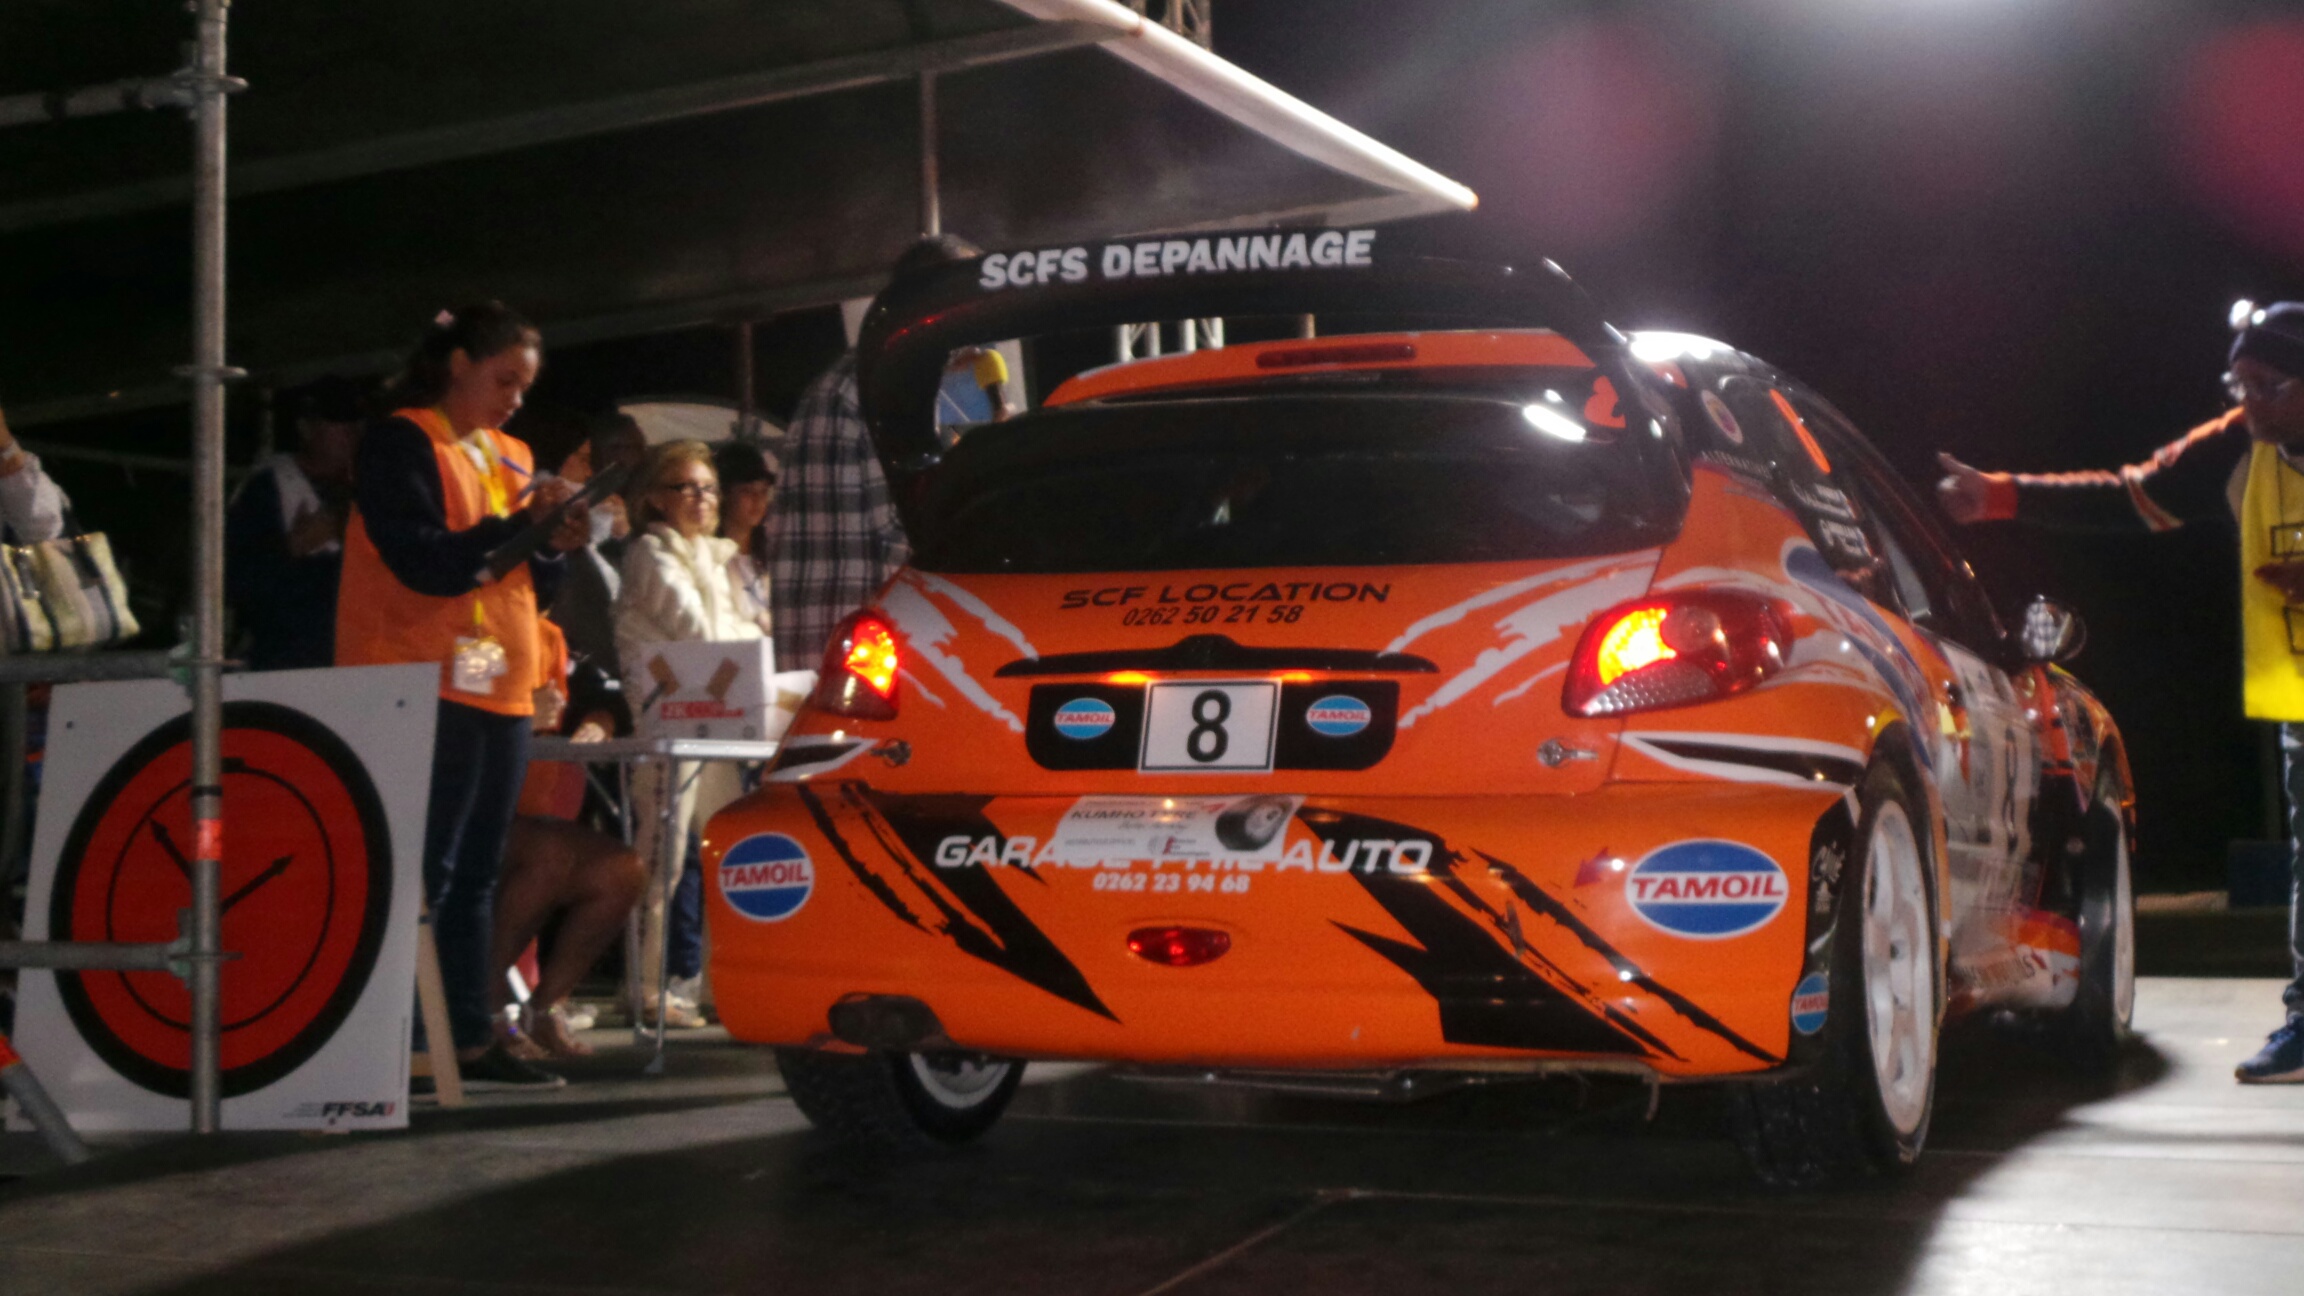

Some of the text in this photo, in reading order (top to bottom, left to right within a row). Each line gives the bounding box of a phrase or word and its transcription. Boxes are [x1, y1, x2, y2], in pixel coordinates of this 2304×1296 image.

[980, 229, 1376, 289] SCFS DEPANNAGE
[1062, 583, 1391, 609] SCF LOCATION
[1123, 605, 1303, 626] 0262 50 21 58
[1056, 713, 1113, 725] TAMOIL
[1186, 689, 1231, 763] 8
[1308, 710, 1368, 722] TAMOIL
[1071, 810, 1145, 819] KUMHO
[1278, 840, 1433, 873] AUTO
[721, 861, 809, 887] TAMOIL
[1093, 872, 1251, 892] 0262 23 94 68
[1632, 875, 1783, 899] TAMOIL
[322, 1101, 386, 1117] FFSA
